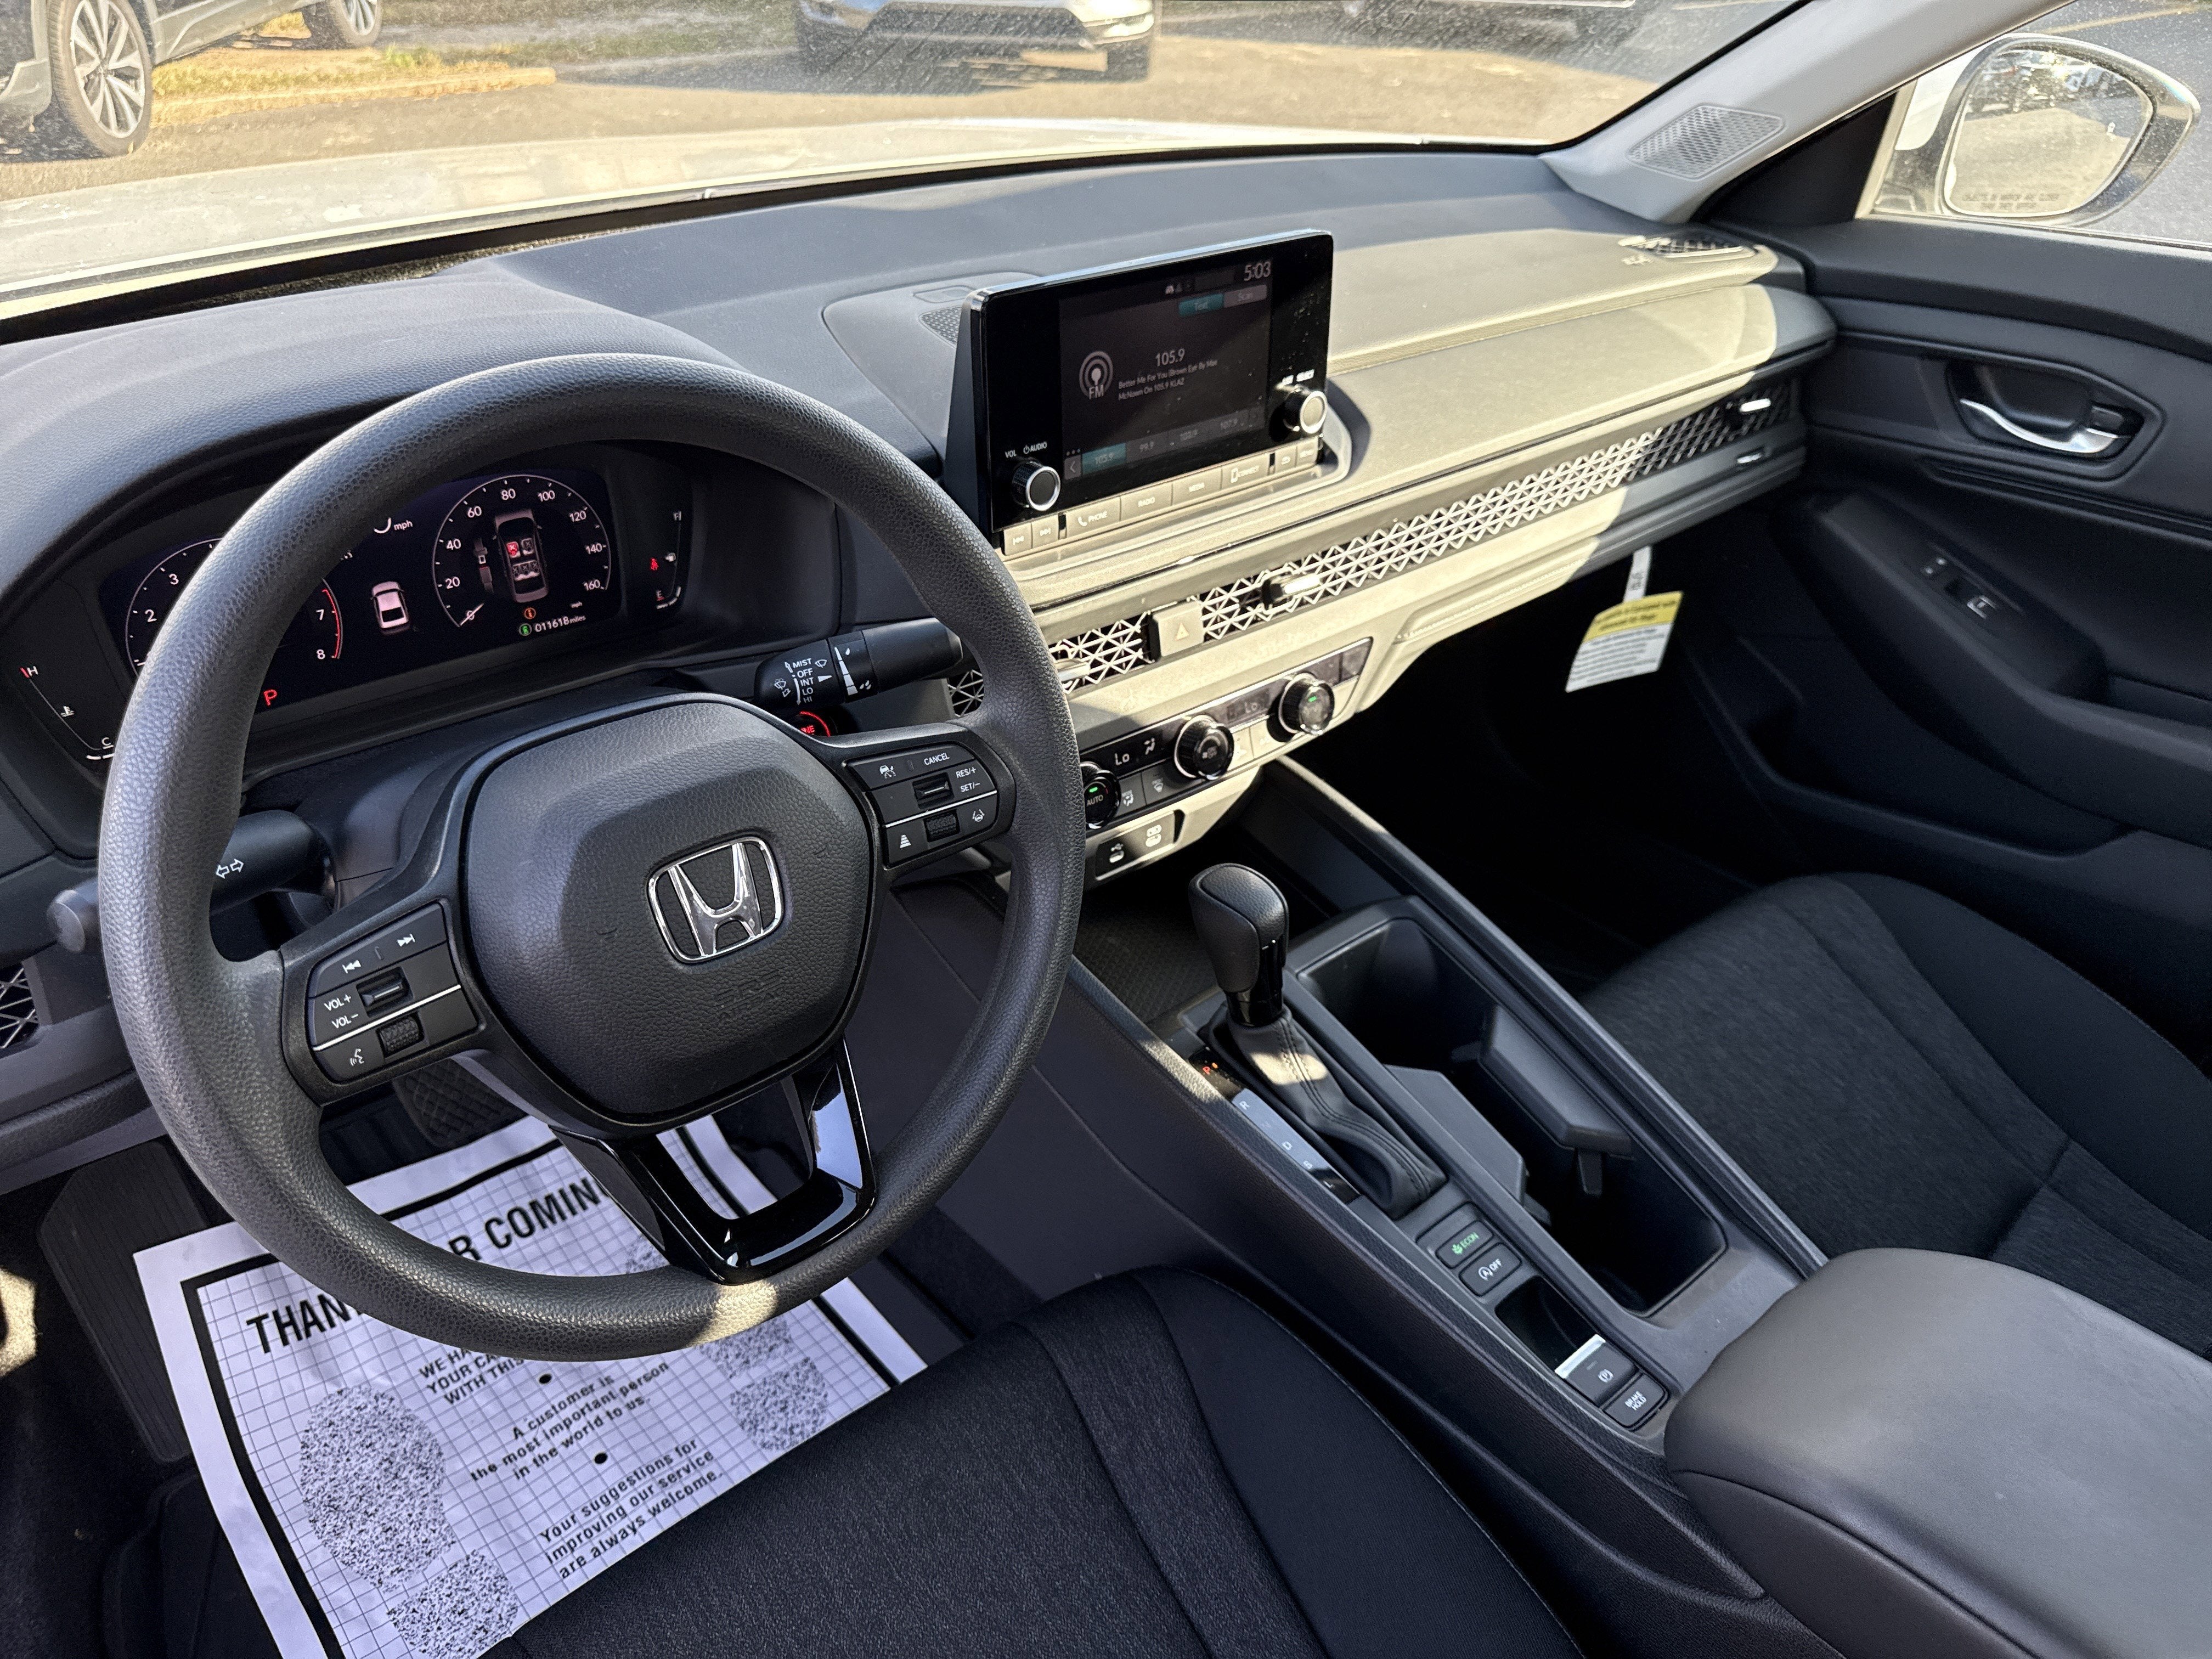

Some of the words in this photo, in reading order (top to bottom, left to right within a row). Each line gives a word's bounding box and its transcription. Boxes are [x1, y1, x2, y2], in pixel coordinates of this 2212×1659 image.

[1244, 261, 1271, 281] 5:03
[1155, 348, 1185, 367] 105.9
[1088, 386, 1104, 399] FM
[1005, 449, 1017, 458] VOL
[1030, 441, 1048, 452] AUDIO
[501, 488, 516, 500] 80
[538, 490, 556, 502] 100
[467, 506, 482, 518] 60
[569, 510, 587, 522] 120
[393, 520, 413, 531] mph
[446, 539, 461, 550] 40
[586, 543, 603, 554] 140
[169, 574, 179, 585] 3
[445, 577, 460, 588] 20
[584, 579, 601, 590] 160
[145, 610, 157, 623] 2
[316, 610, 324, 620] 7
[534, 616, 569, 633] 011618
[569, 616, 586, 624] miles
[317, 649, 325, 660] 8
[792, 658, 812, 669] MIST
[797, 668, 813, 678] OFF
[800, 677, 814, 687] INT
[263, 689, 278, 706] P
[802, 687, 814, 696] LO
[924, 752, 950, 766] CANCEL
[1115, 752, 1130, 765] Lo
[955, 766, 977, 778] RES/+
[1087, 794, 1104, 806] AUTO
[1239, 1101, 1250, 1110] R
[1282, 1141, 1292, 1150] D
[1303, 1160, 1313, 1170] S
[1459, 1232, 1480, 1249] ECON
[246, 1293, 362, 1353] THAN
[484, 1177, 609, 1249] COMIN
[1489, 1259, 1502, 1271] OFF
[419, 1357, 447, 1378] WE
[427, 1364, 472, 1394] YOUR
[474, 1352, 501, 1369] CA
[444, 1373, 487, 1405] WITH
[512, 1426, 524, 1440] A
[527, 1383, 595, 1430] customer
[598, 1374, 614, 1388] is
[1631, 1396, 1647, 1410] HOLD
[470, 1463, 498, 1482] the
[502, 1436, 541, 1466] most
[542, 1391, 617, 1440] important
[619, 1362, 669, 1397] person
[513, 1466, 531, 1480] in
[532, 1447, 559, 1468] the
[561, 1415, 604, 1449] world
[605, 1407, 623, 1421] to
[540, 1513, 578, 1543] Your
[581, 1453, 674, 1517] suggestions
[674, 1438, 698, 1458] for
[545, 1504, 628, 1565] improving
[629, 1484, 655, 1507] our
[658, 1451, 714, 1489] service
[560, 1555, 588, 1579] are
[590, 1514, 646, 1559] always
[649, 1470, 725, 1517] welcome.
